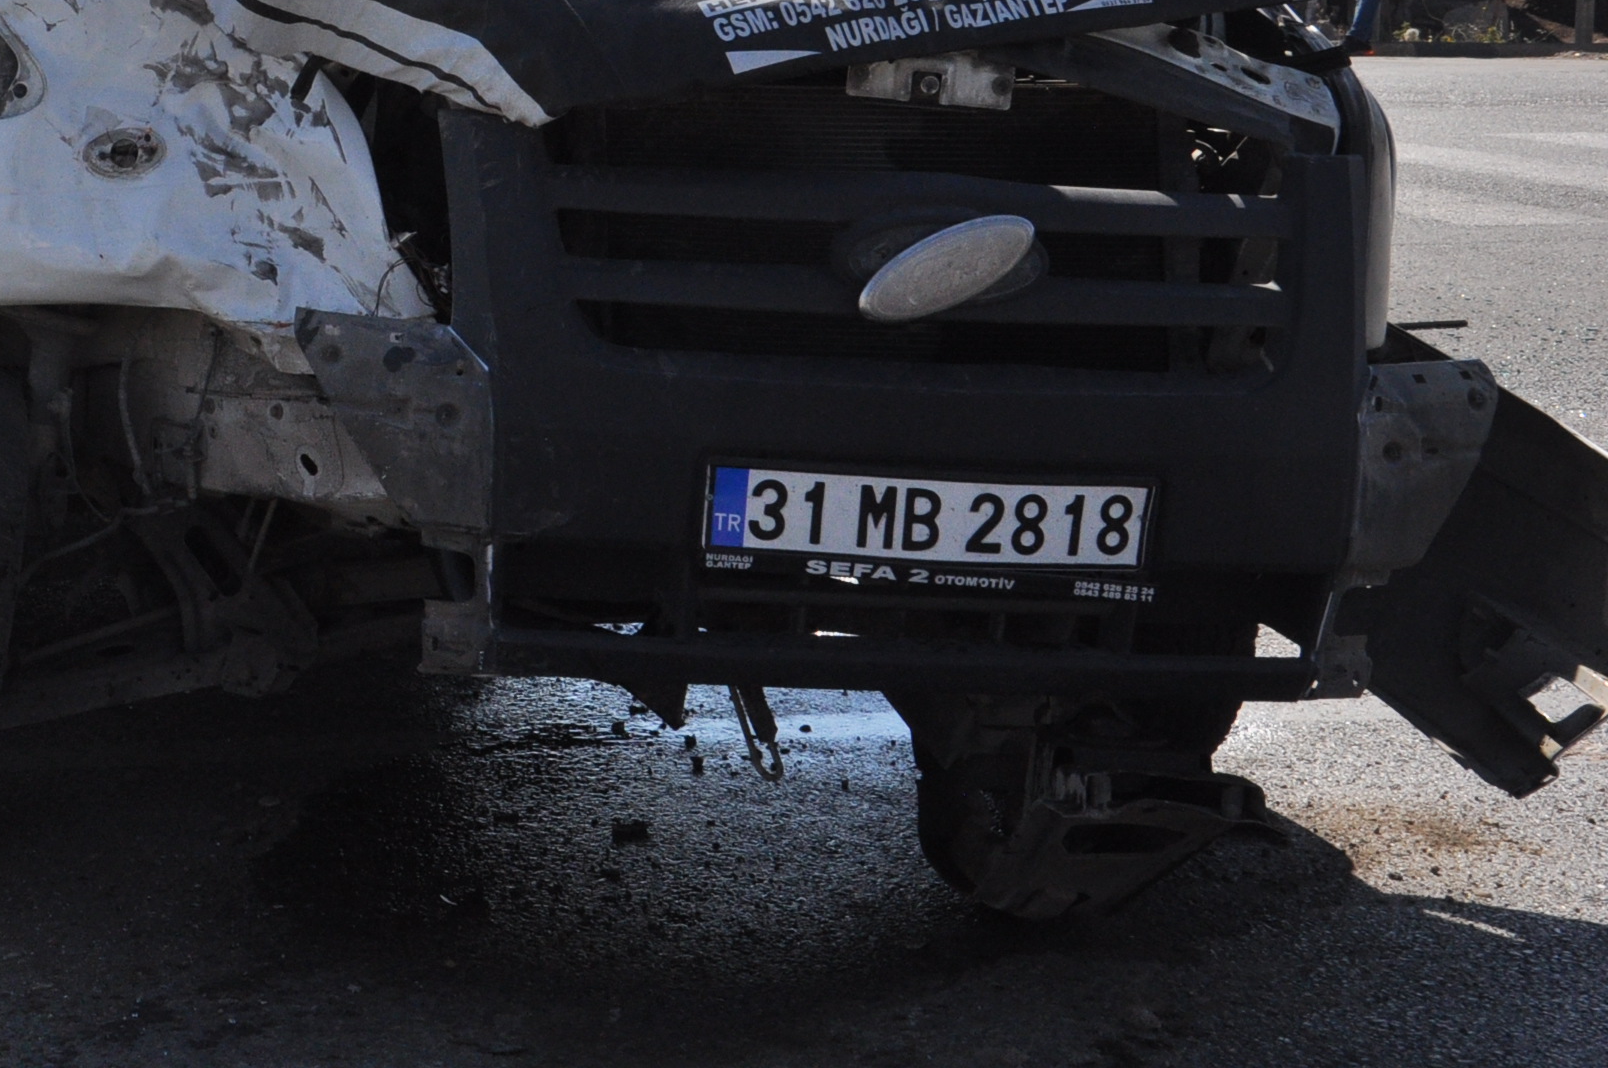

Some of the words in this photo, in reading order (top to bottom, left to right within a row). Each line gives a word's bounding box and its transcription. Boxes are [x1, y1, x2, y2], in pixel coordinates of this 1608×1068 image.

[713, 8, 780, 42] GSM:
[824, 5, 930, 52] NURDAĞI
[714, 512, 742, 532] TR
[747, 478, 826, 545] 31
[856, 484, 942, 552] MB
[964, 492, 1134, 556] 2818
[805, 559, 897, 581] SEFA
[908, 568, 929, 584] 2
[934, 575, 1016, 590] OTOMOTİV
[1074, 580, 1101, 590] 0542
[1141, 587, 1155, 595] 24
[1073, 588, 1099, 597] 0543
[1101, 591, 1122, 600] 489
[1124, 593, 1137, 601] 83
[1140, 594, 1153, 602] 11
